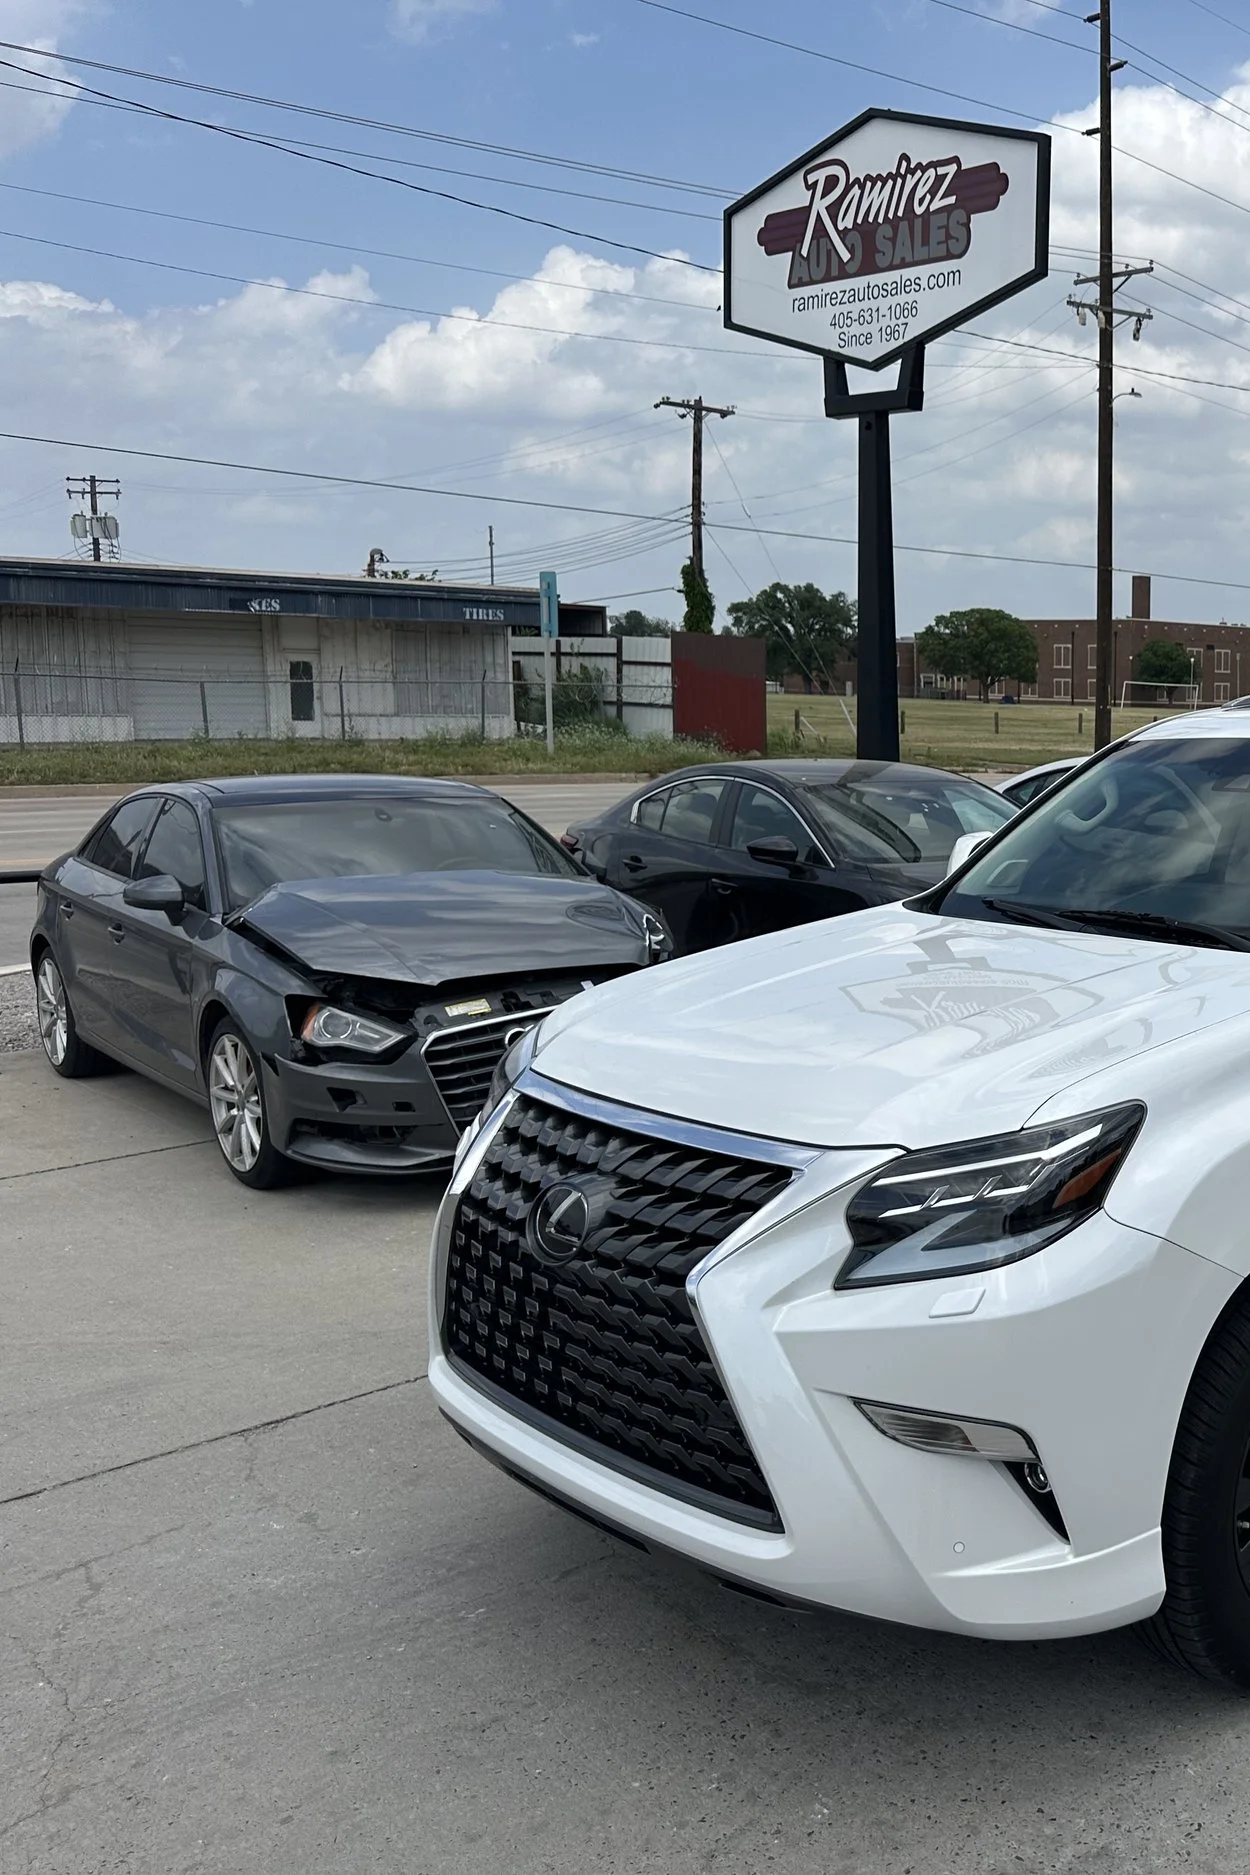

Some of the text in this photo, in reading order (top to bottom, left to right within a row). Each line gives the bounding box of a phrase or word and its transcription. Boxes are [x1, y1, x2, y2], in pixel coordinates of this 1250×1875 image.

[801, 159, 958, 263] Ramirez
[790, 209, 968, 285] AUTO SALES
[792, 269, 962, 313] ramirezautosales.com
[829, 300, 919, 330] 405-631-1066
[837, 322, 909, 349] Since 1967
[462, 607, 505, 621] TIRES
